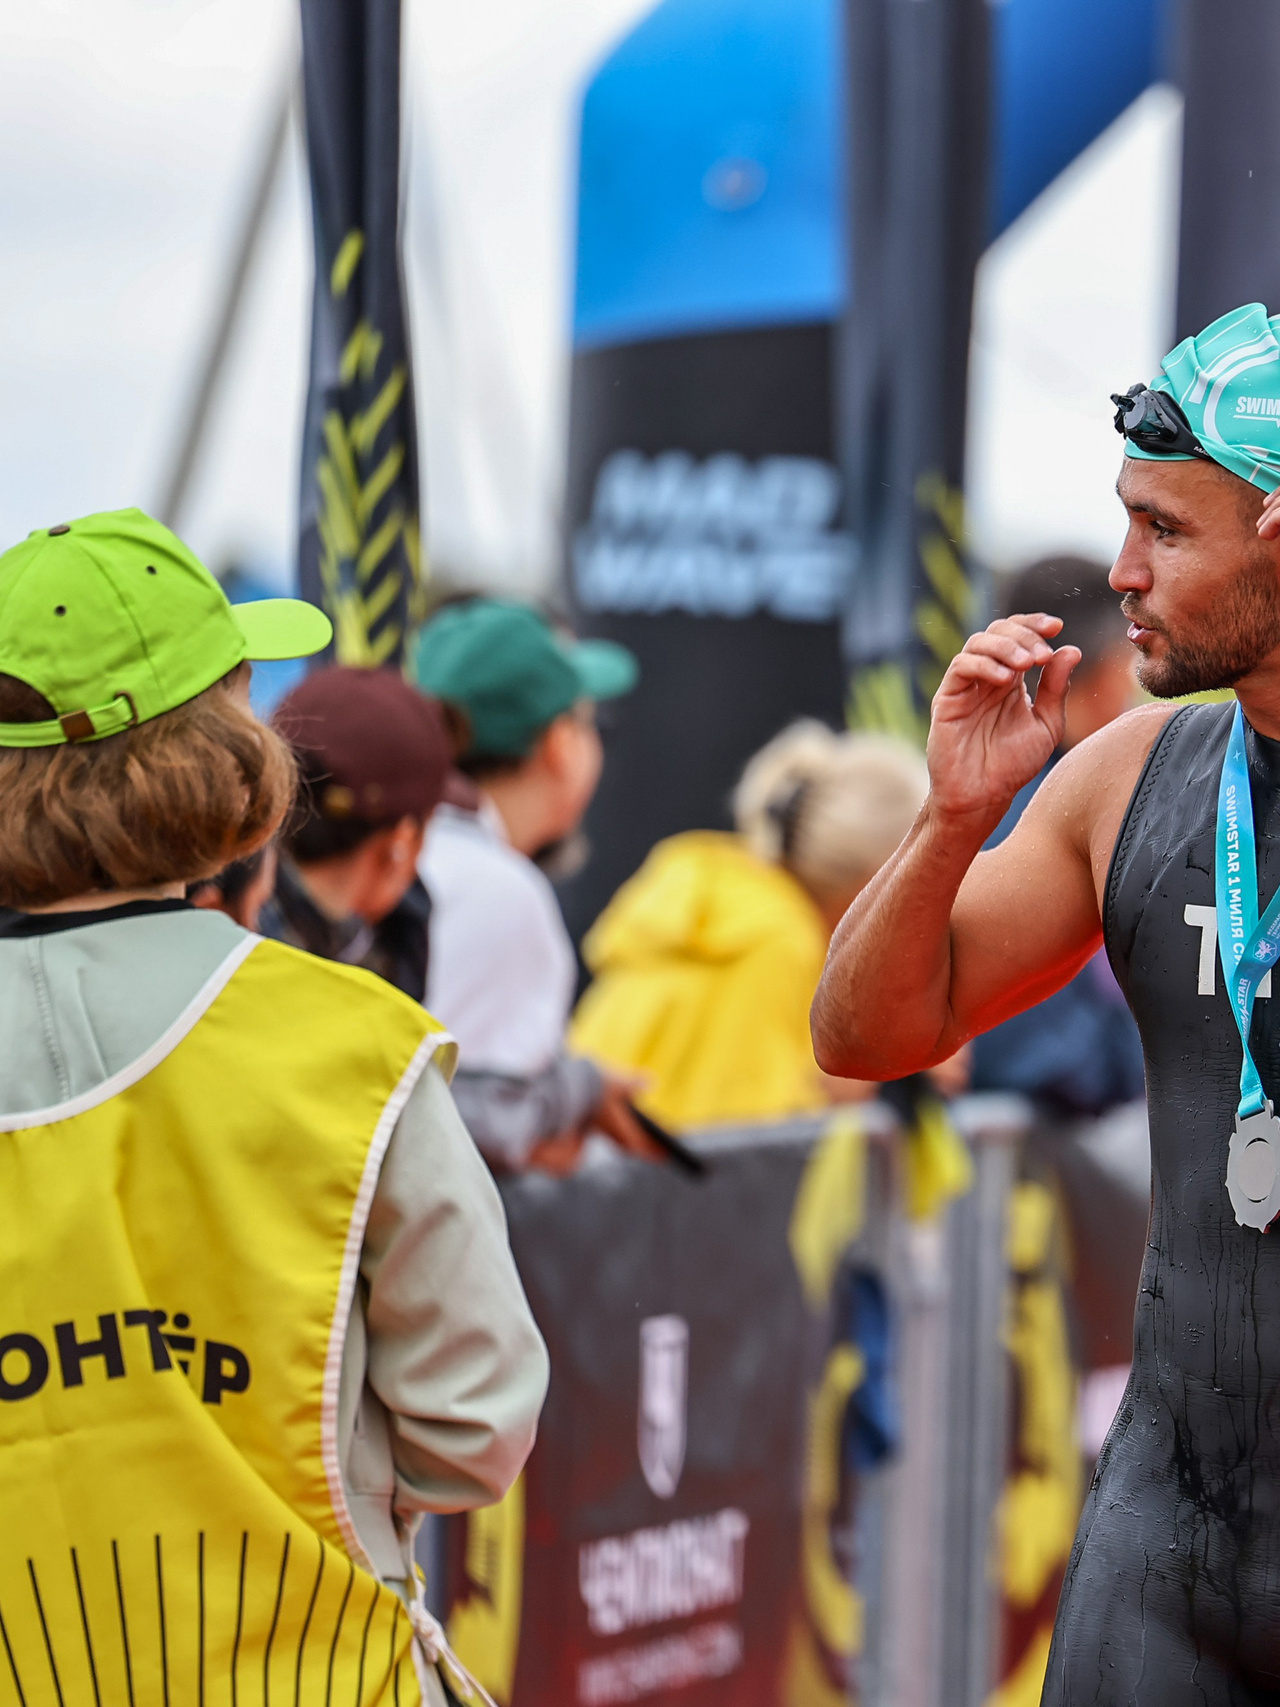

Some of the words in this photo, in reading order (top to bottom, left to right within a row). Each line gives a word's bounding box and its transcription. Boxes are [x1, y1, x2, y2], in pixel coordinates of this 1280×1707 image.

[1226, 784, 1240, 874] SWIMSTAR
[1228, 876, 1241, 886] 1
[1229, 888, 1244, 938] МИЛЯ
[1237, 978, 1249, 1006] STAR
